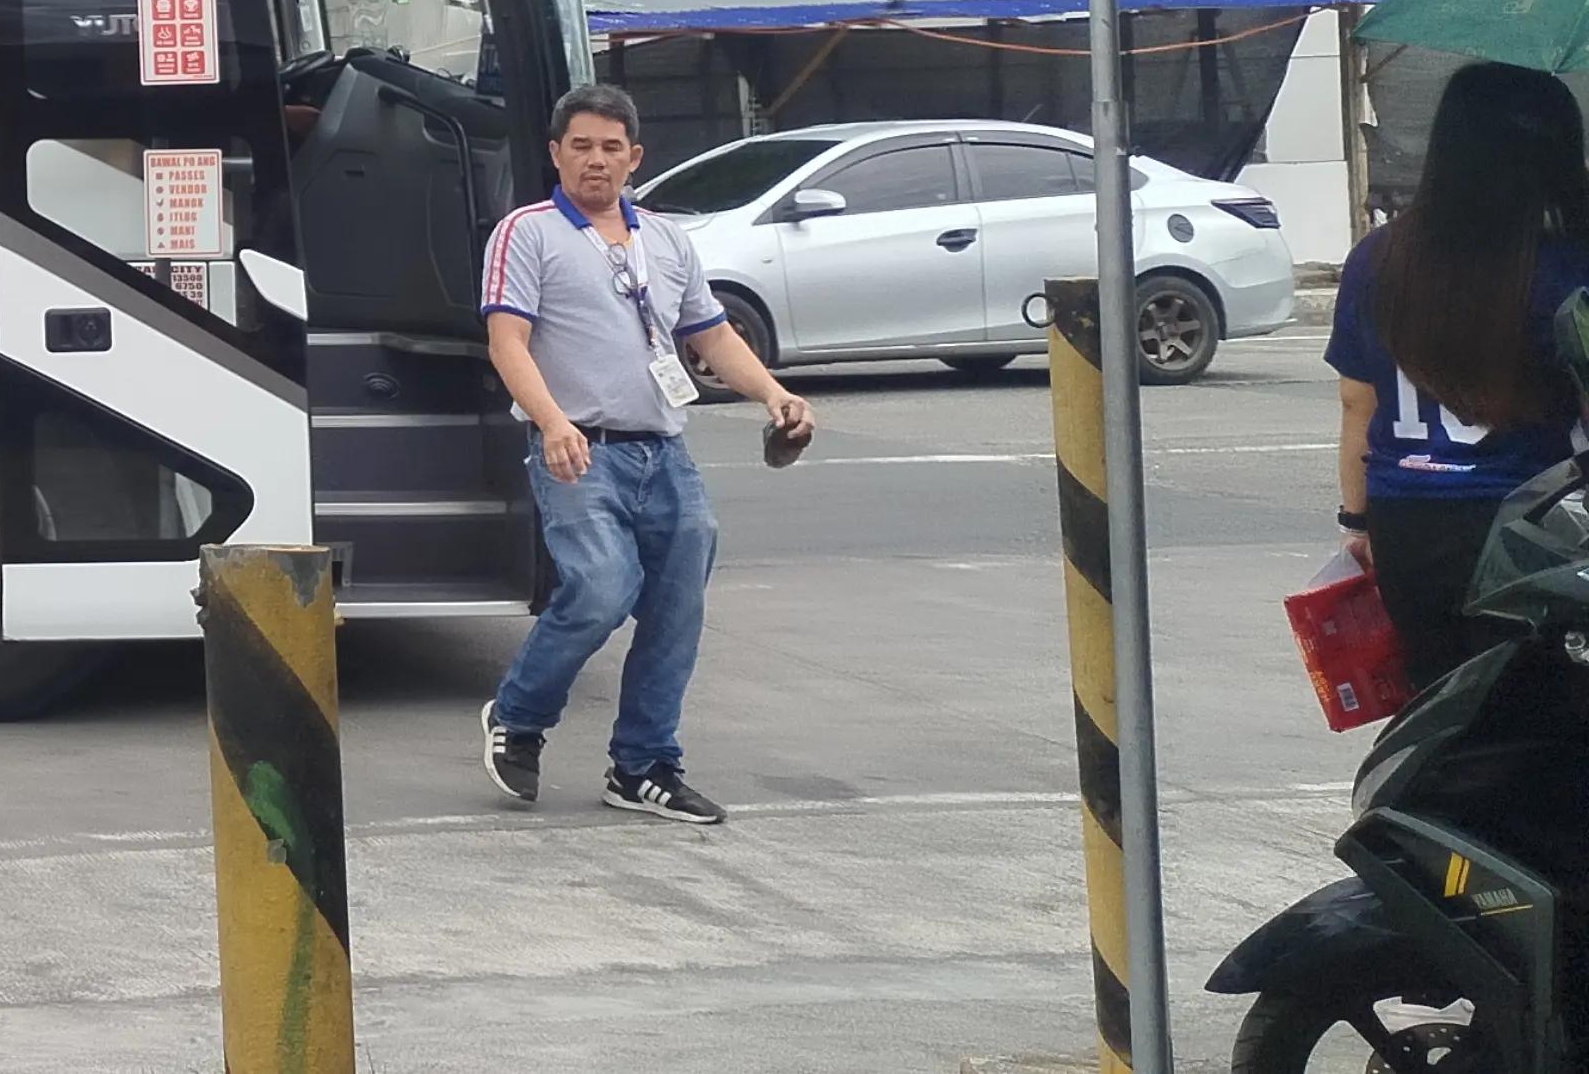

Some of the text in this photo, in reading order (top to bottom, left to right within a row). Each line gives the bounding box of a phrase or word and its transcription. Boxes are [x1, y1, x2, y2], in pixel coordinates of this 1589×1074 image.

[150, 156, 216, 167] BAWAL PO ANG
[168, 170, 206, 180] PASSES
[168, 184, 208, 194] VENDOR
[169, 198, 204, 208] MANOK
[170, 239, 196, 249] MAIS
